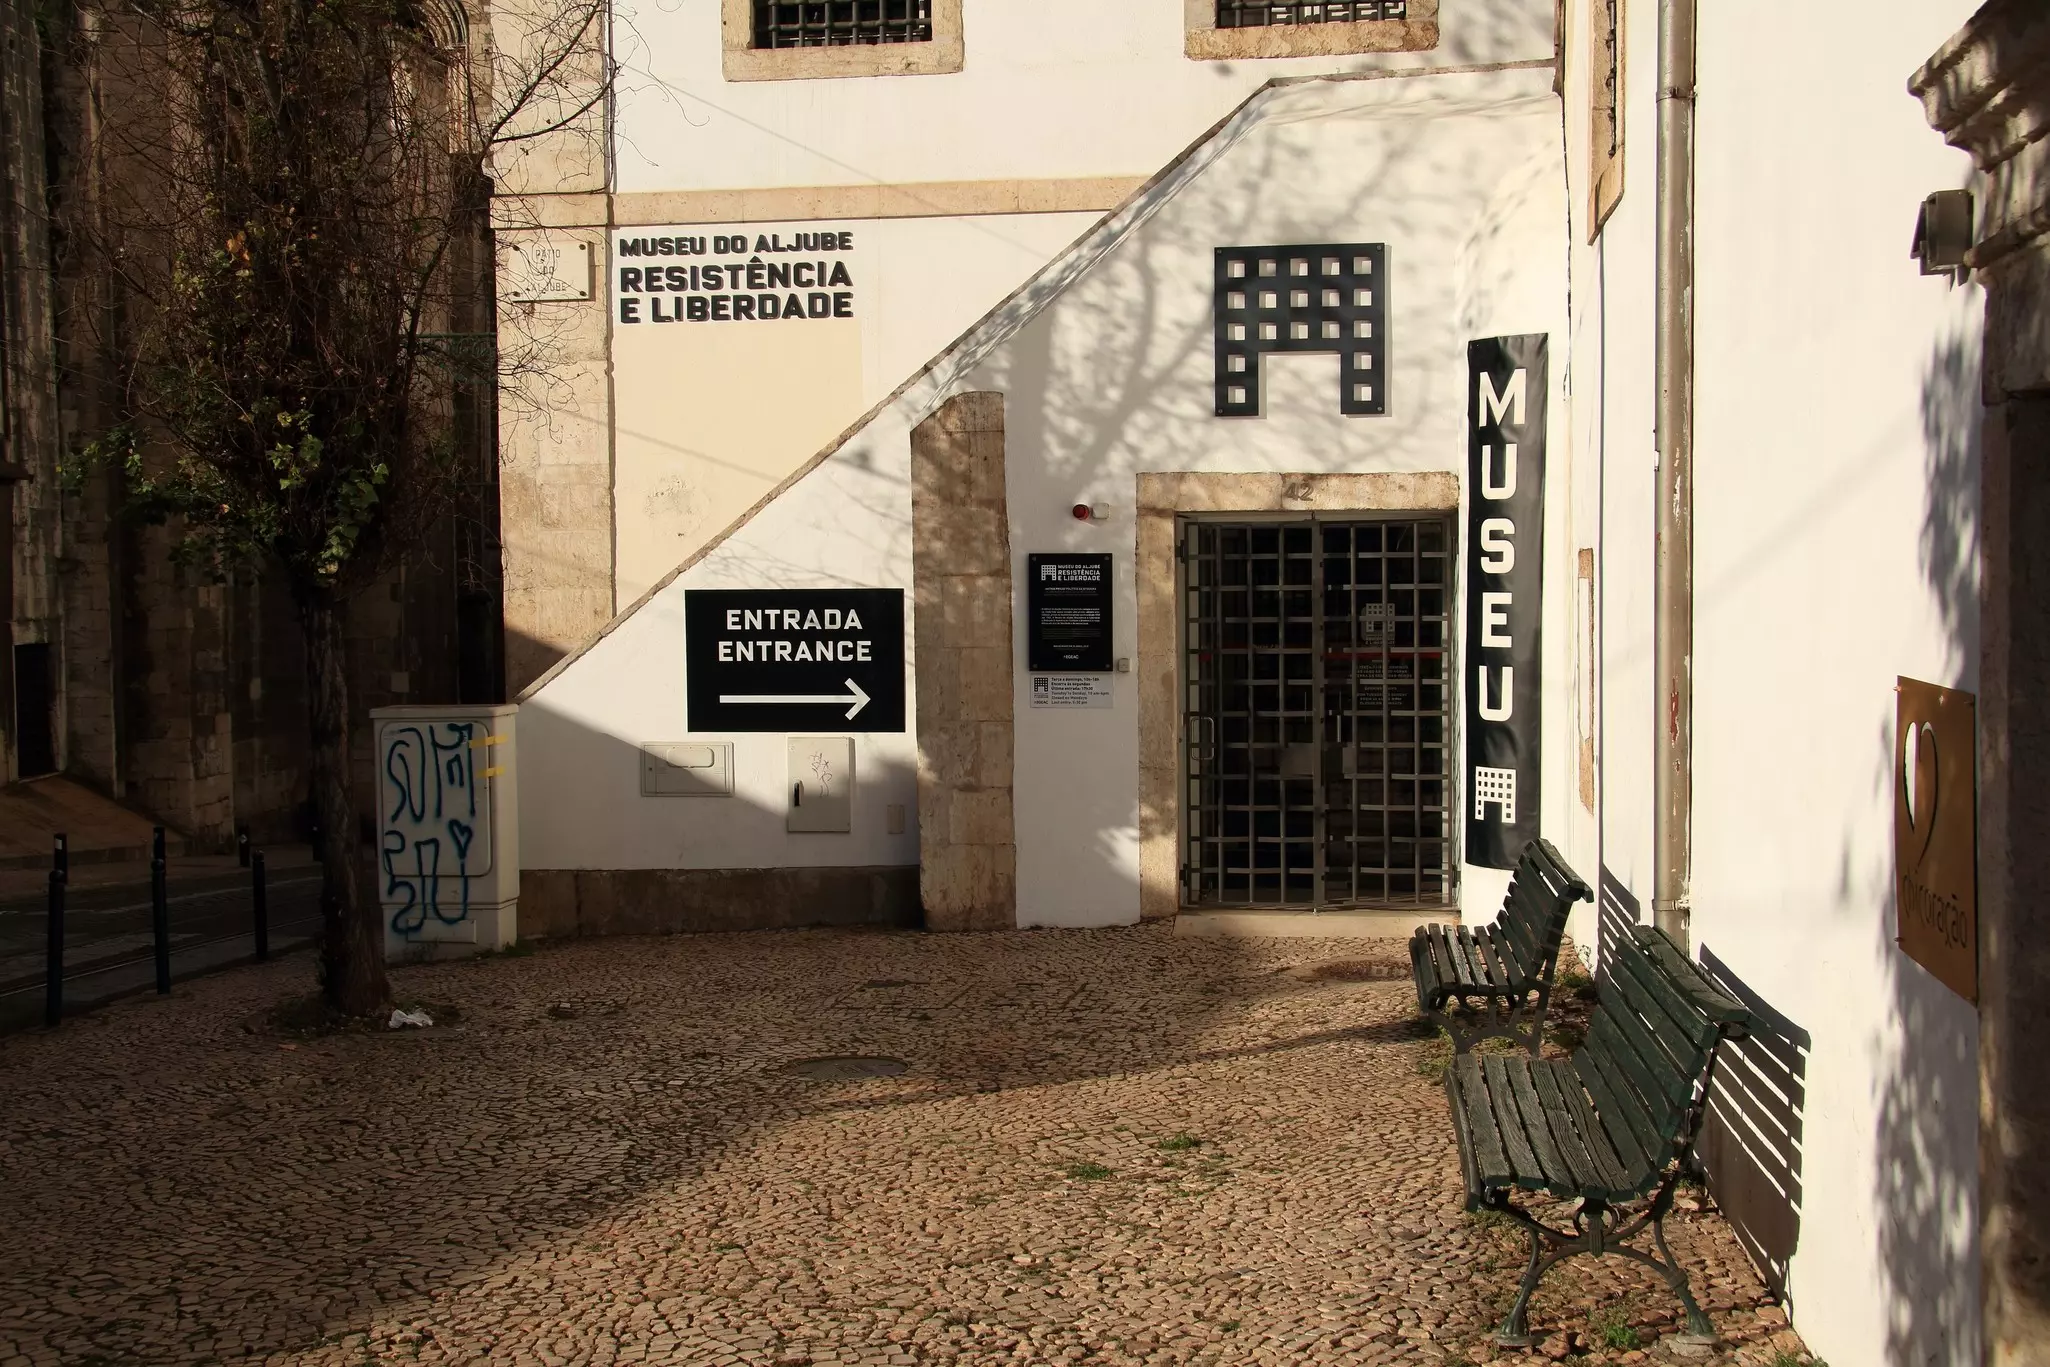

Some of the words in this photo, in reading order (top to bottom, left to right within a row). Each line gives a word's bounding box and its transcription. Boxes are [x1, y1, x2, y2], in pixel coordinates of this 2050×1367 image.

[619, 236, 706, 257] MUSEU
[713, 235, 748, 255] DO
[754, 231, 854, 253] ALJUBE
[620, 256, 854, 293] RESISTÊNCIA
[620, 297, 641, 324] E
[651, 291, 854, 323] LIBERDADE
[1283, 481, 1314, 502] 42
[1478, 368, 1527, 722] MUSEU
[1057, 568, 1101, 576] RESISTÊNCIA
[726, 608, 863, 631] ENTRADA
[718, 640, 872, 662] ENTRANCE
